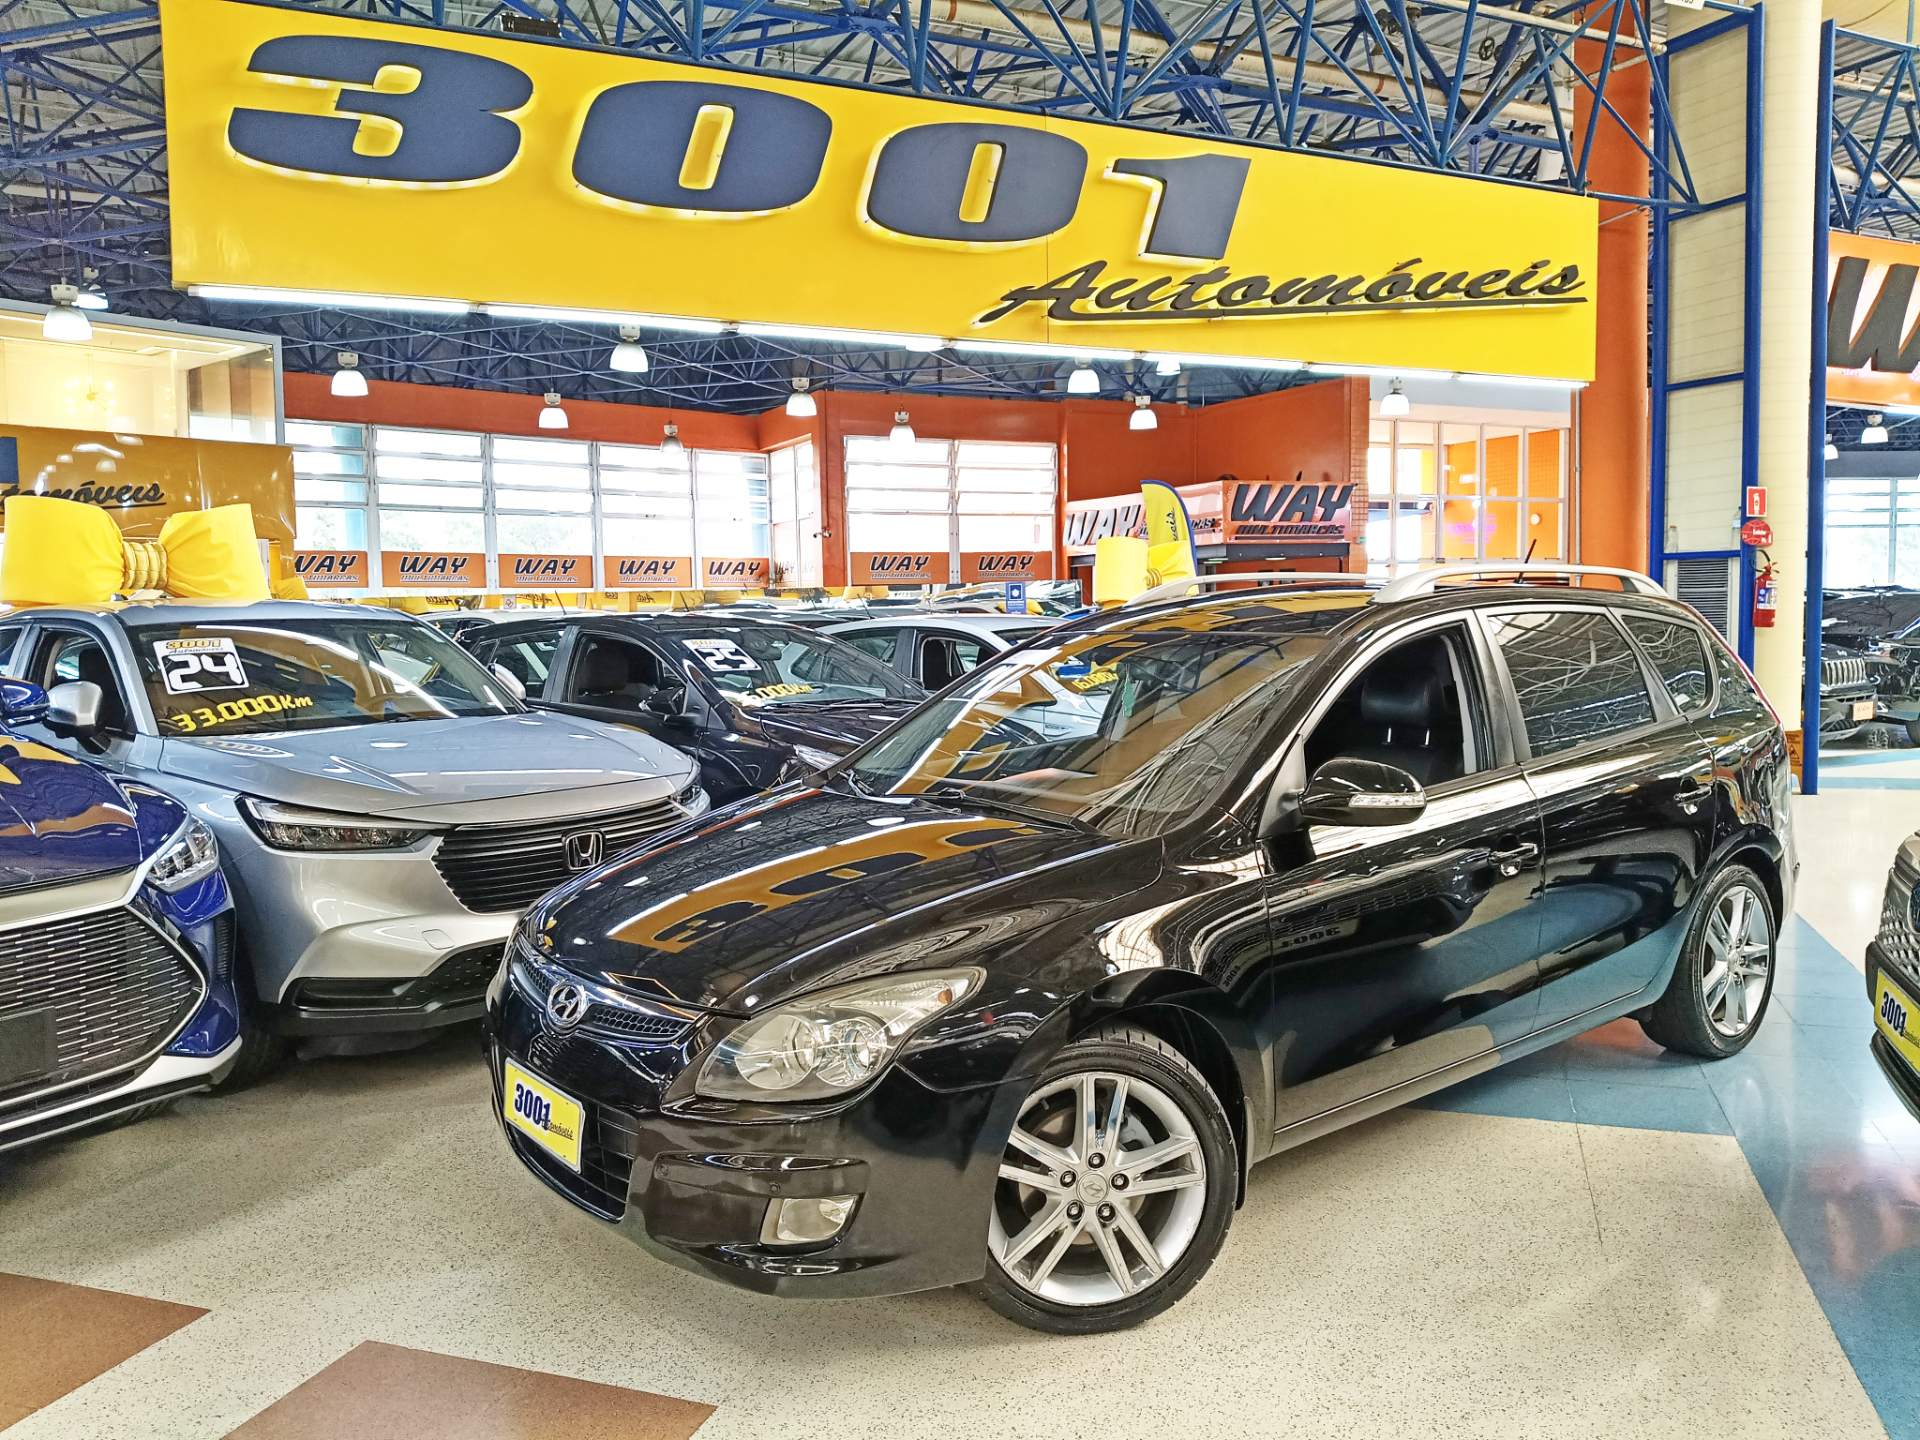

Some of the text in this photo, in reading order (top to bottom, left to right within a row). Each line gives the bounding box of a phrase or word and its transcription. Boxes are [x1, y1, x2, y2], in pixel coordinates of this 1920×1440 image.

[228, 34, 1252, 260] 3001
[975, 259, 1588, 325] Automóveis
[1231, 484, 1354, 522] WAY
[1063, 504, 1142, 546] WAY
[400, 555, 469, 574] WAY
[514, 558, 577, 575] WAY
[619, 559, 676, 575] WAY
[709, 561, 761, 576] WAY
[870, 555, 930, 572] WAY
[978, 556, 1033, 571] WAY
[167, 653, 243, 691] 24
[699, 648, 758, 670] 25
[1881, 991, 1907, 1037] 3001
[515, 1083, 551, 1131] 3001
